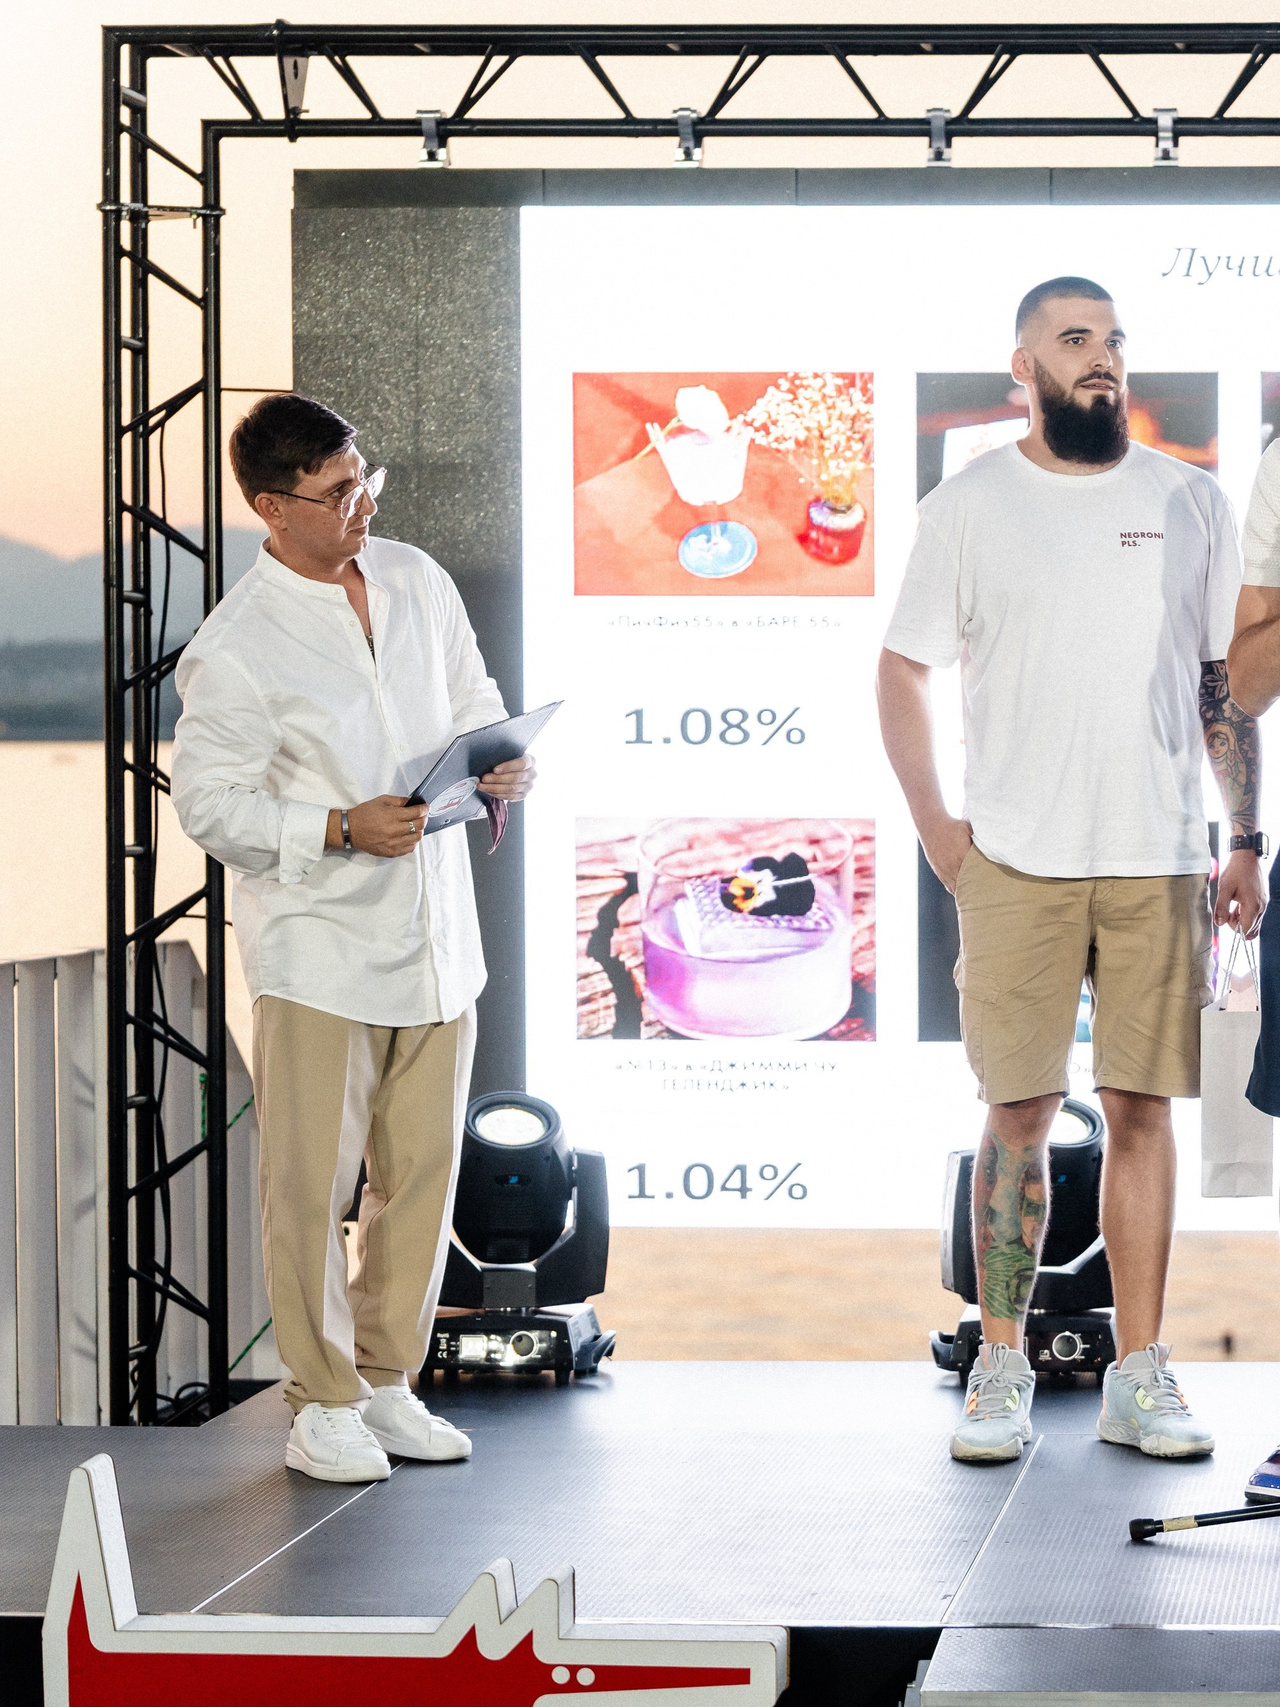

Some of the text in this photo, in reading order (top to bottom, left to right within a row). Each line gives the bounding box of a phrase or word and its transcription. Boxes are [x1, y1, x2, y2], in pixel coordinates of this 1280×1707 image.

[746, 616, 799, 627] «БАРЕ
[810, 616, 841, 627] 55»
[625, 706, 806, 746] 1.08%
[700, 1060, 807, 1072] «ДЖИММИ
[663, 1079, 790, 1091] ГЕЛЕНДЖИК»
[627, 1162, 808, 1201] 1.04%
